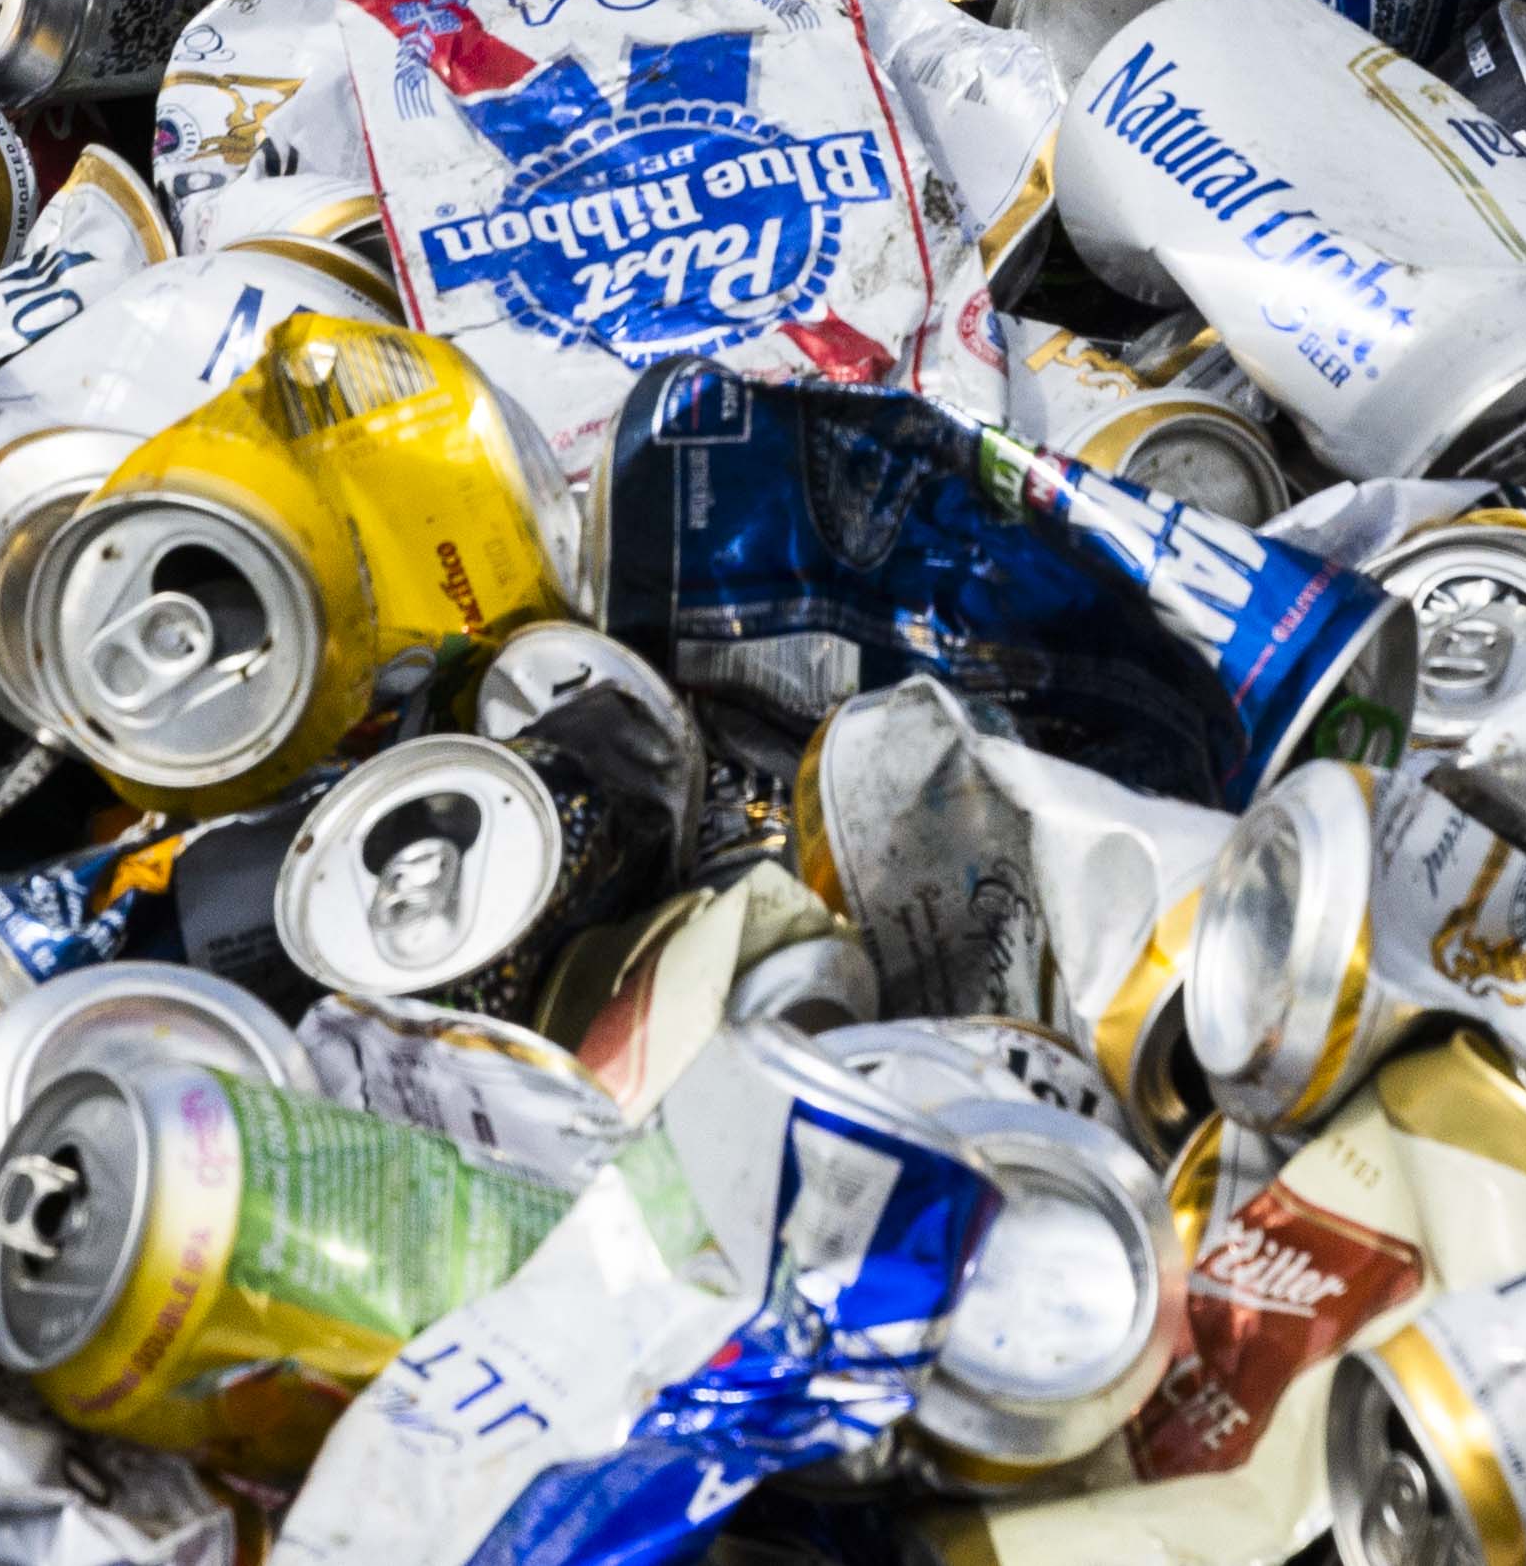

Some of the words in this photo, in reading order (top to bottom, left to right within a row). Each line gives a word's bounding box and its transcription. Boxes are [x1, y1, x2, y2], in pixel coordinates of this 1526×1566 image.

[703, 136, 877, 201] Blue
[1087, 40, 1295, 222] Natural
[0, 137, 32, 240] IMPORTED
[434, 172, 700, 262] Ribbon
[570, 215, 782, 320] Pabst
[1298, 333, 1354, 390] BEER
[1196, 1217, 1348, 1316] Miller
